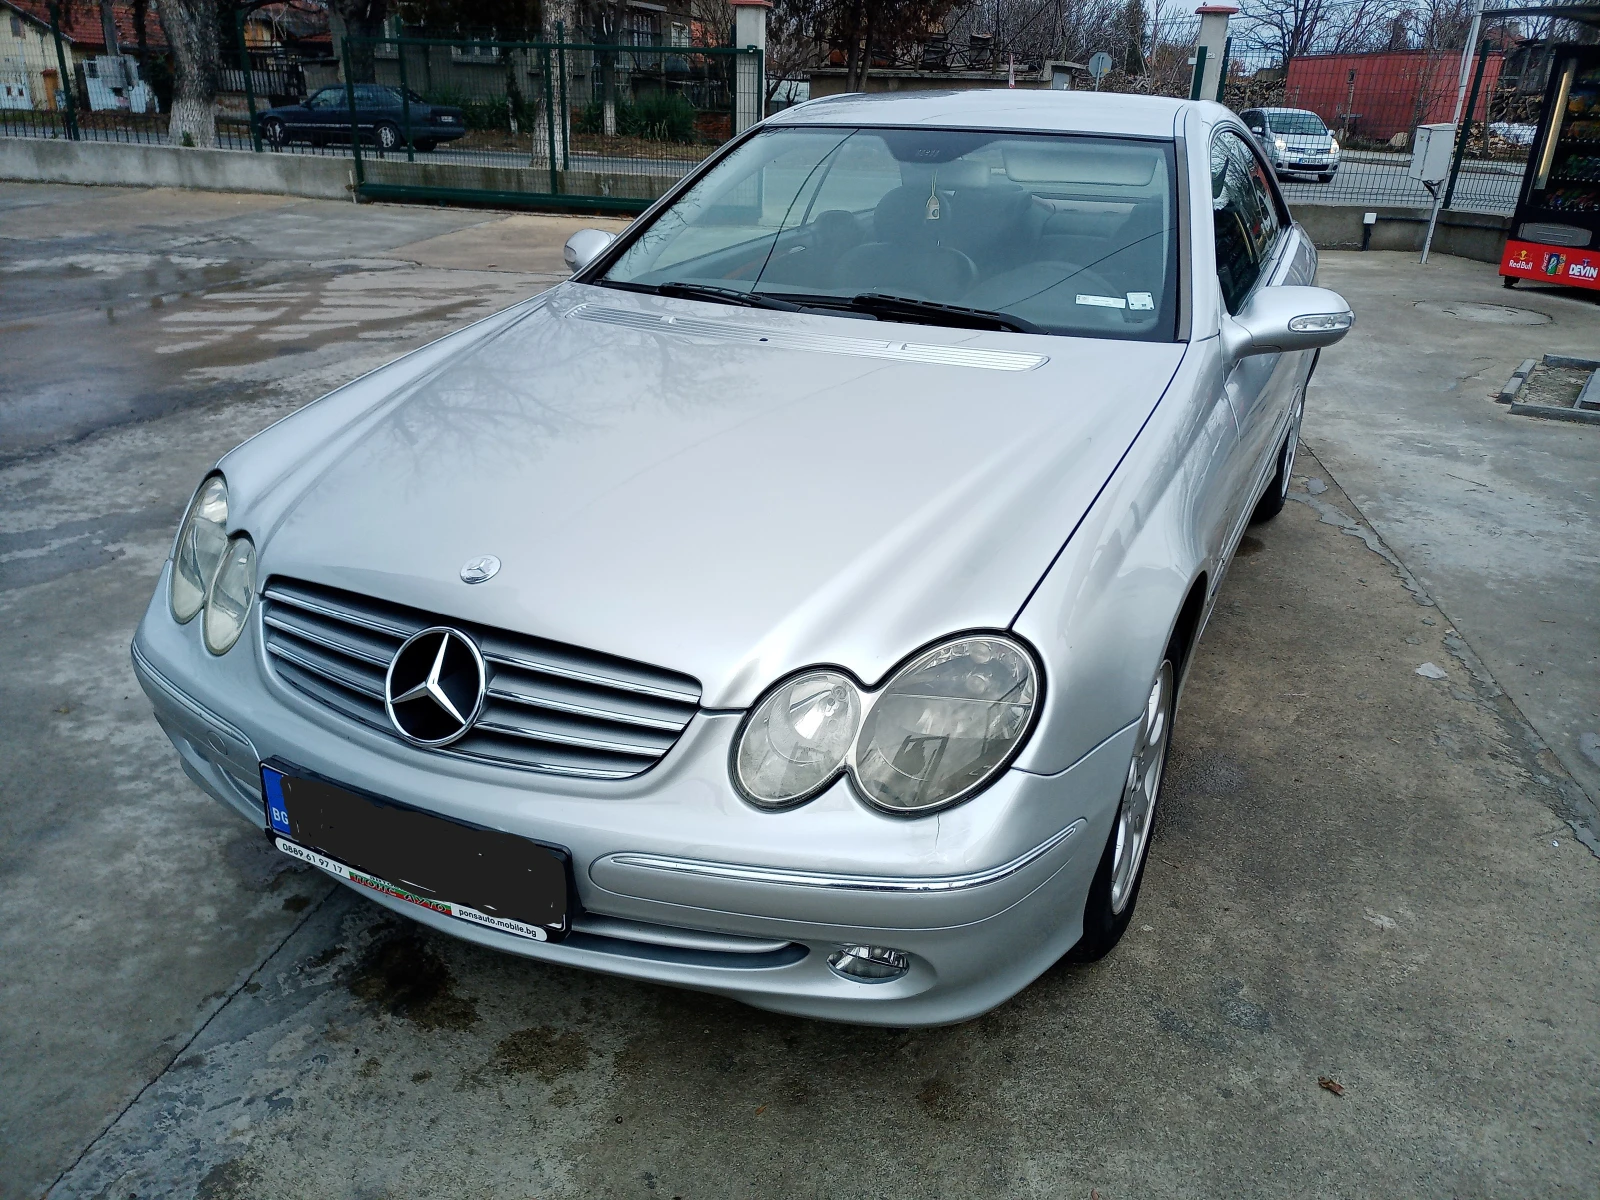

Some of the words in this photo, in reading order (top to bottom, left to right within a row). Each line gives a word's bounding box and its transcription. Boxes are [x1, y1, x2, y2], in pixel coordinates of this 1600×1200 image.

[1568, 263, 1599, 279] DEVIN
[272, 806, 289, 825] BG
[282, 843, 304, 857] 0889
[305, 853, 316, 863] 61
[318, 858, 329, 868] 97
[332, 863, 343, 874] 17
[458, 908, 537, 938] ponsauto.mobile.bg
